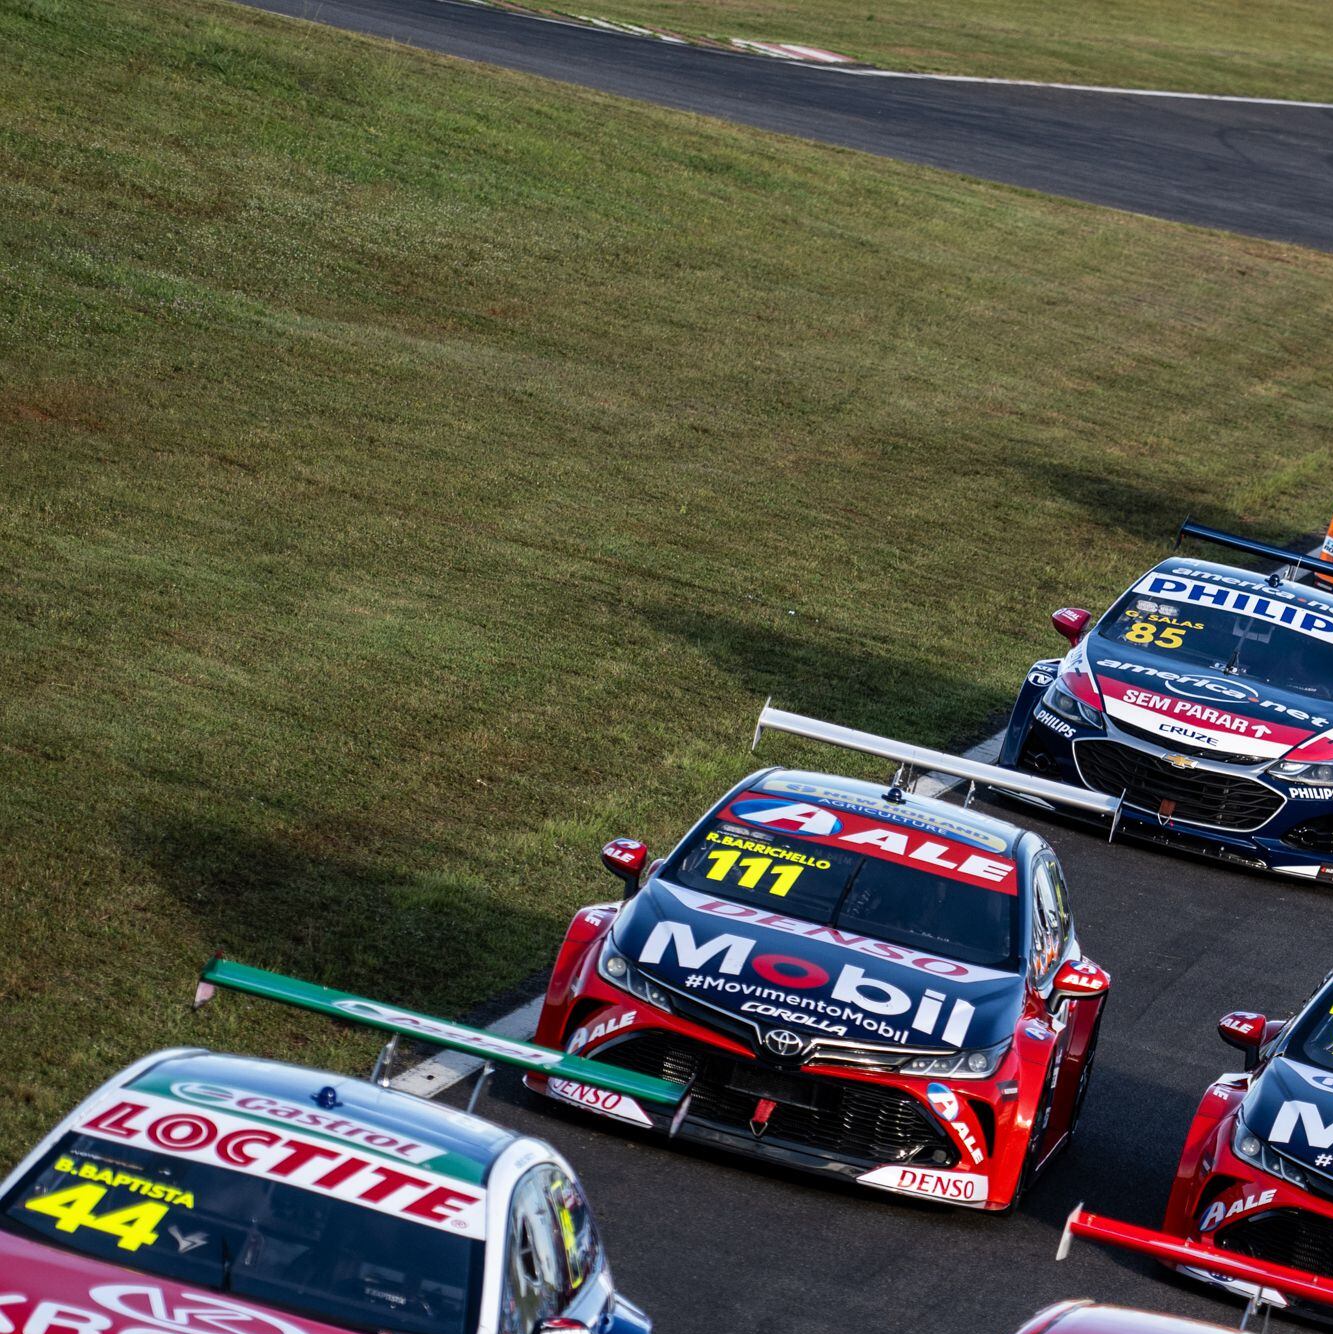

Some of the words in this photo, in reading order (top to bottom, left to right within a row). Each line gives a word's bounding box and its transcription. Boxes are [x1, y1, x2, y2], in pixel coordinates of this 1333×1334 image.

[1124, 623, 1187, 649] 85
[1125, 610, 1141, 618] G.
[1148, 615, 1205, 630] SALAS
[1036, 710, 1076, 738] PHILIPS
[1124, 689, 1168, 711] SEM
[1174, 700, 1249, 733] PARAR
[1159, 723, 1219, 746] CRUZE
[817, 798, 949, 835] AGRICULTURE
[706, 832, 831, 870] R.BARRICHELLO
[838, 828, 1015, 883] ALE
[706, 850, 805, 897] 111
[698, 899, 971, 978] DENSO
[638, 920, 976, 1048] Mobil
[591, 1010, 637, 1041] ALE
[684, 973, 910, 1047] #MovimentoMobil
[740, 1001, 848, 1037] COROLLA
[234, 1096, 424, 1158] Castrol
[953, 1122, 985, 1165] ALE
[54, 1154, 195, 1209] B.BAPTISTA
[84, 1101, 481, 1224] LOCTITE
[900, 1169, 975, 1200] DENSO
[1226, 1189, 1277, 1219] ALE
[24, 1183, 170, 1252] 44
